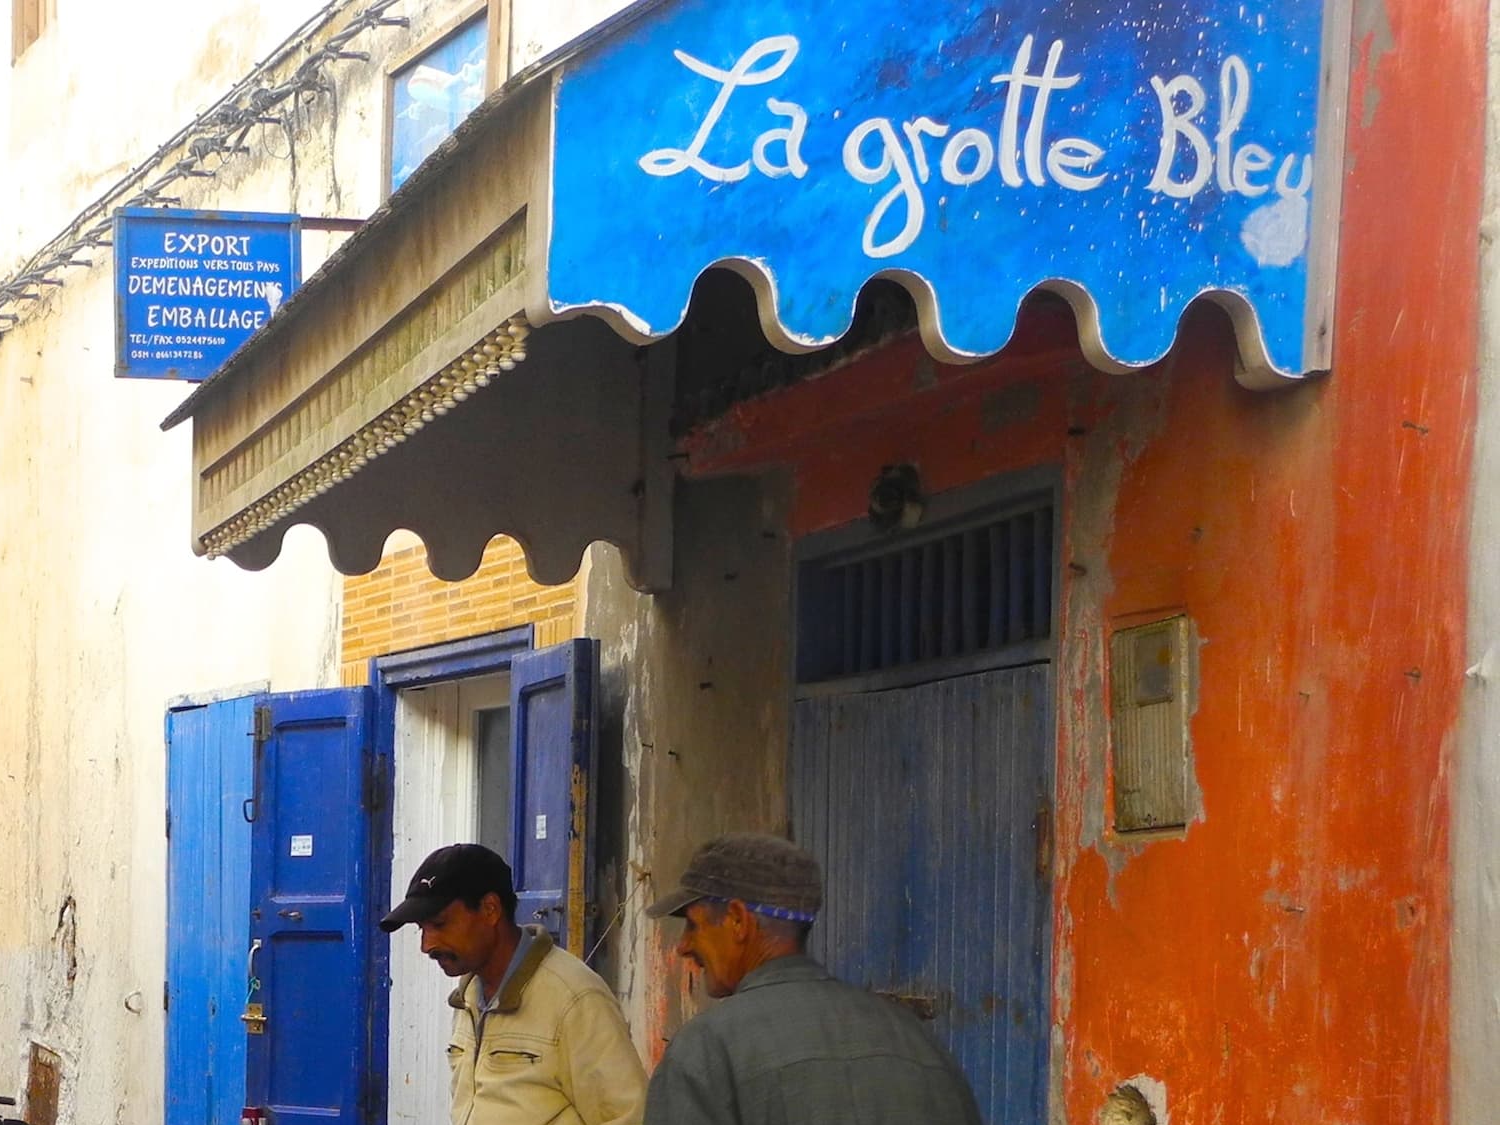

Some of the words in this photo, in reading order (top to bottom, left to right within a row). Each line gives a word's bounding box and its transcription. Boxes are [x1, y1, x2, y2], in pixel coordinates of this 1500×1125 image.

[638, 34, 808, 181] La
[842, 34, 1105, 258] grotte
[164, 232, 251, 256] EXPORT
[203, 260, 228, 271] VERS
[231, 260, 254, 272] TOUS
[147, 305, 264, 329] EMBALLAGE
